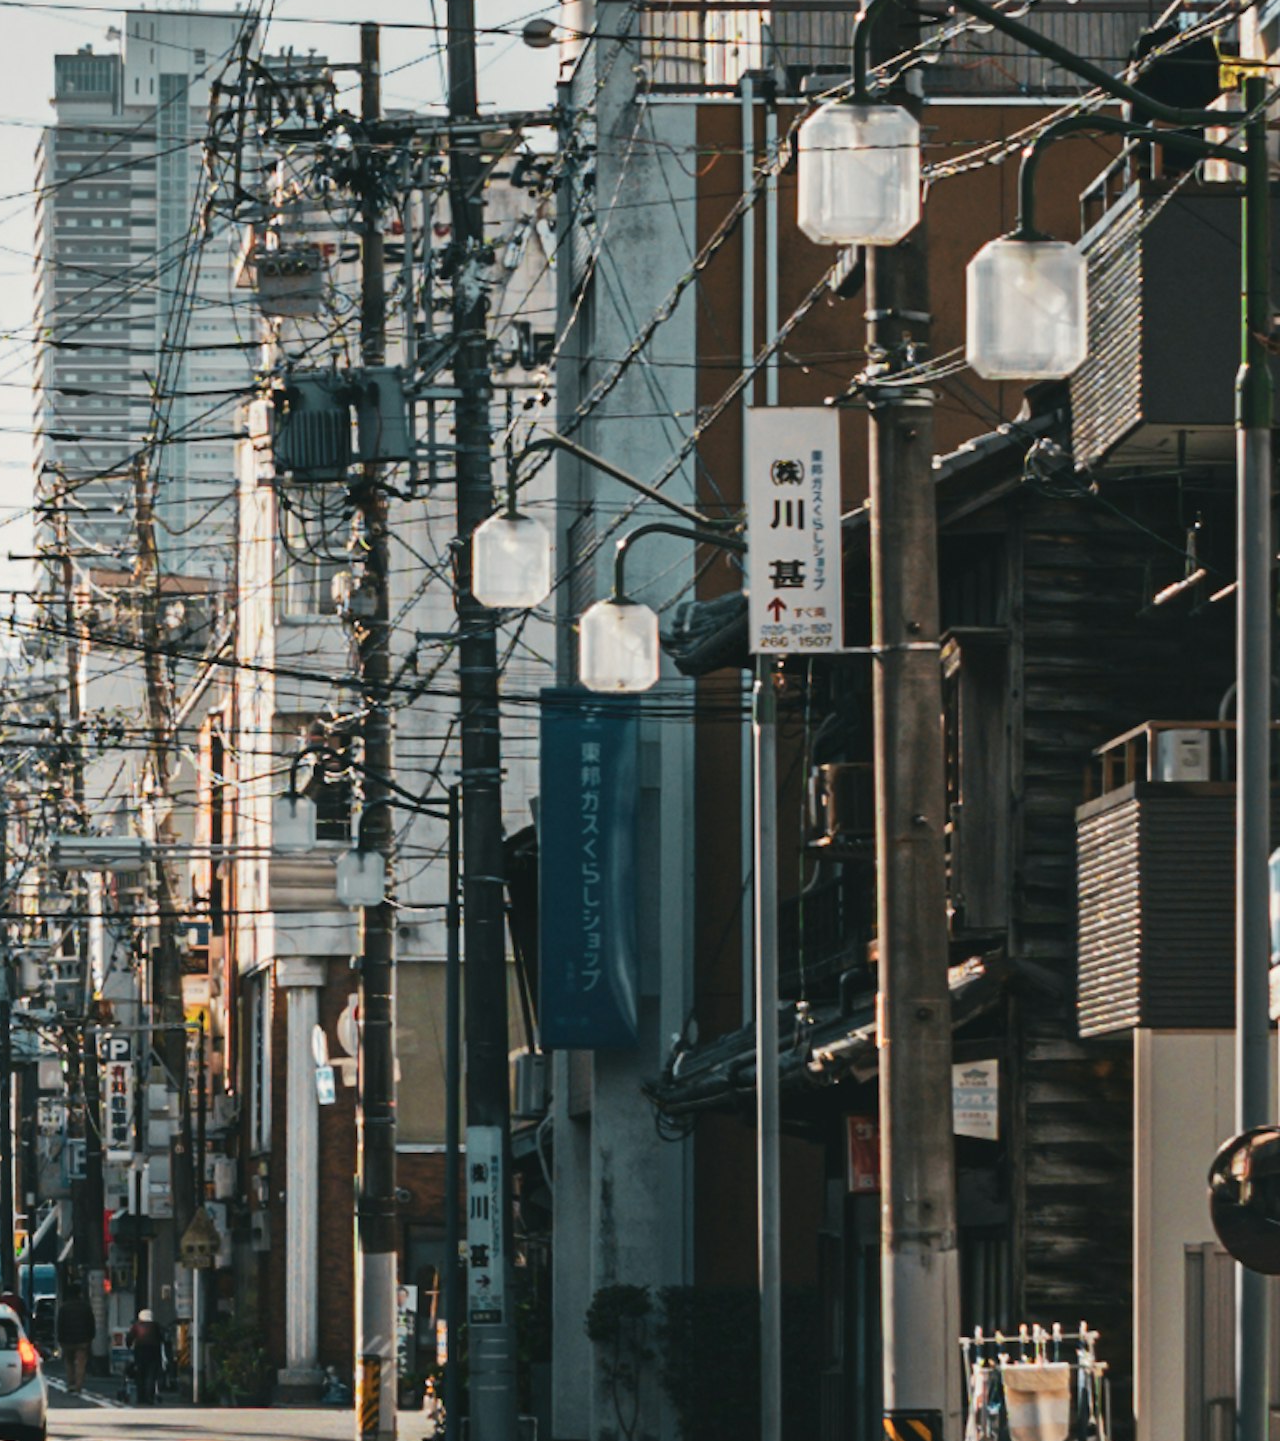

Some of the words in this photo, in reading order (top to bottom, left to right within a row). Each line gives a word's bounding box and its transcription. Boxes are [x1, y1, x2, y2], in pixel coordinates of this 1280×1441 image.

[580, 742, 602, 992] 東邦ガスくらしショップ
[110, 1039, 128, 1060] P
